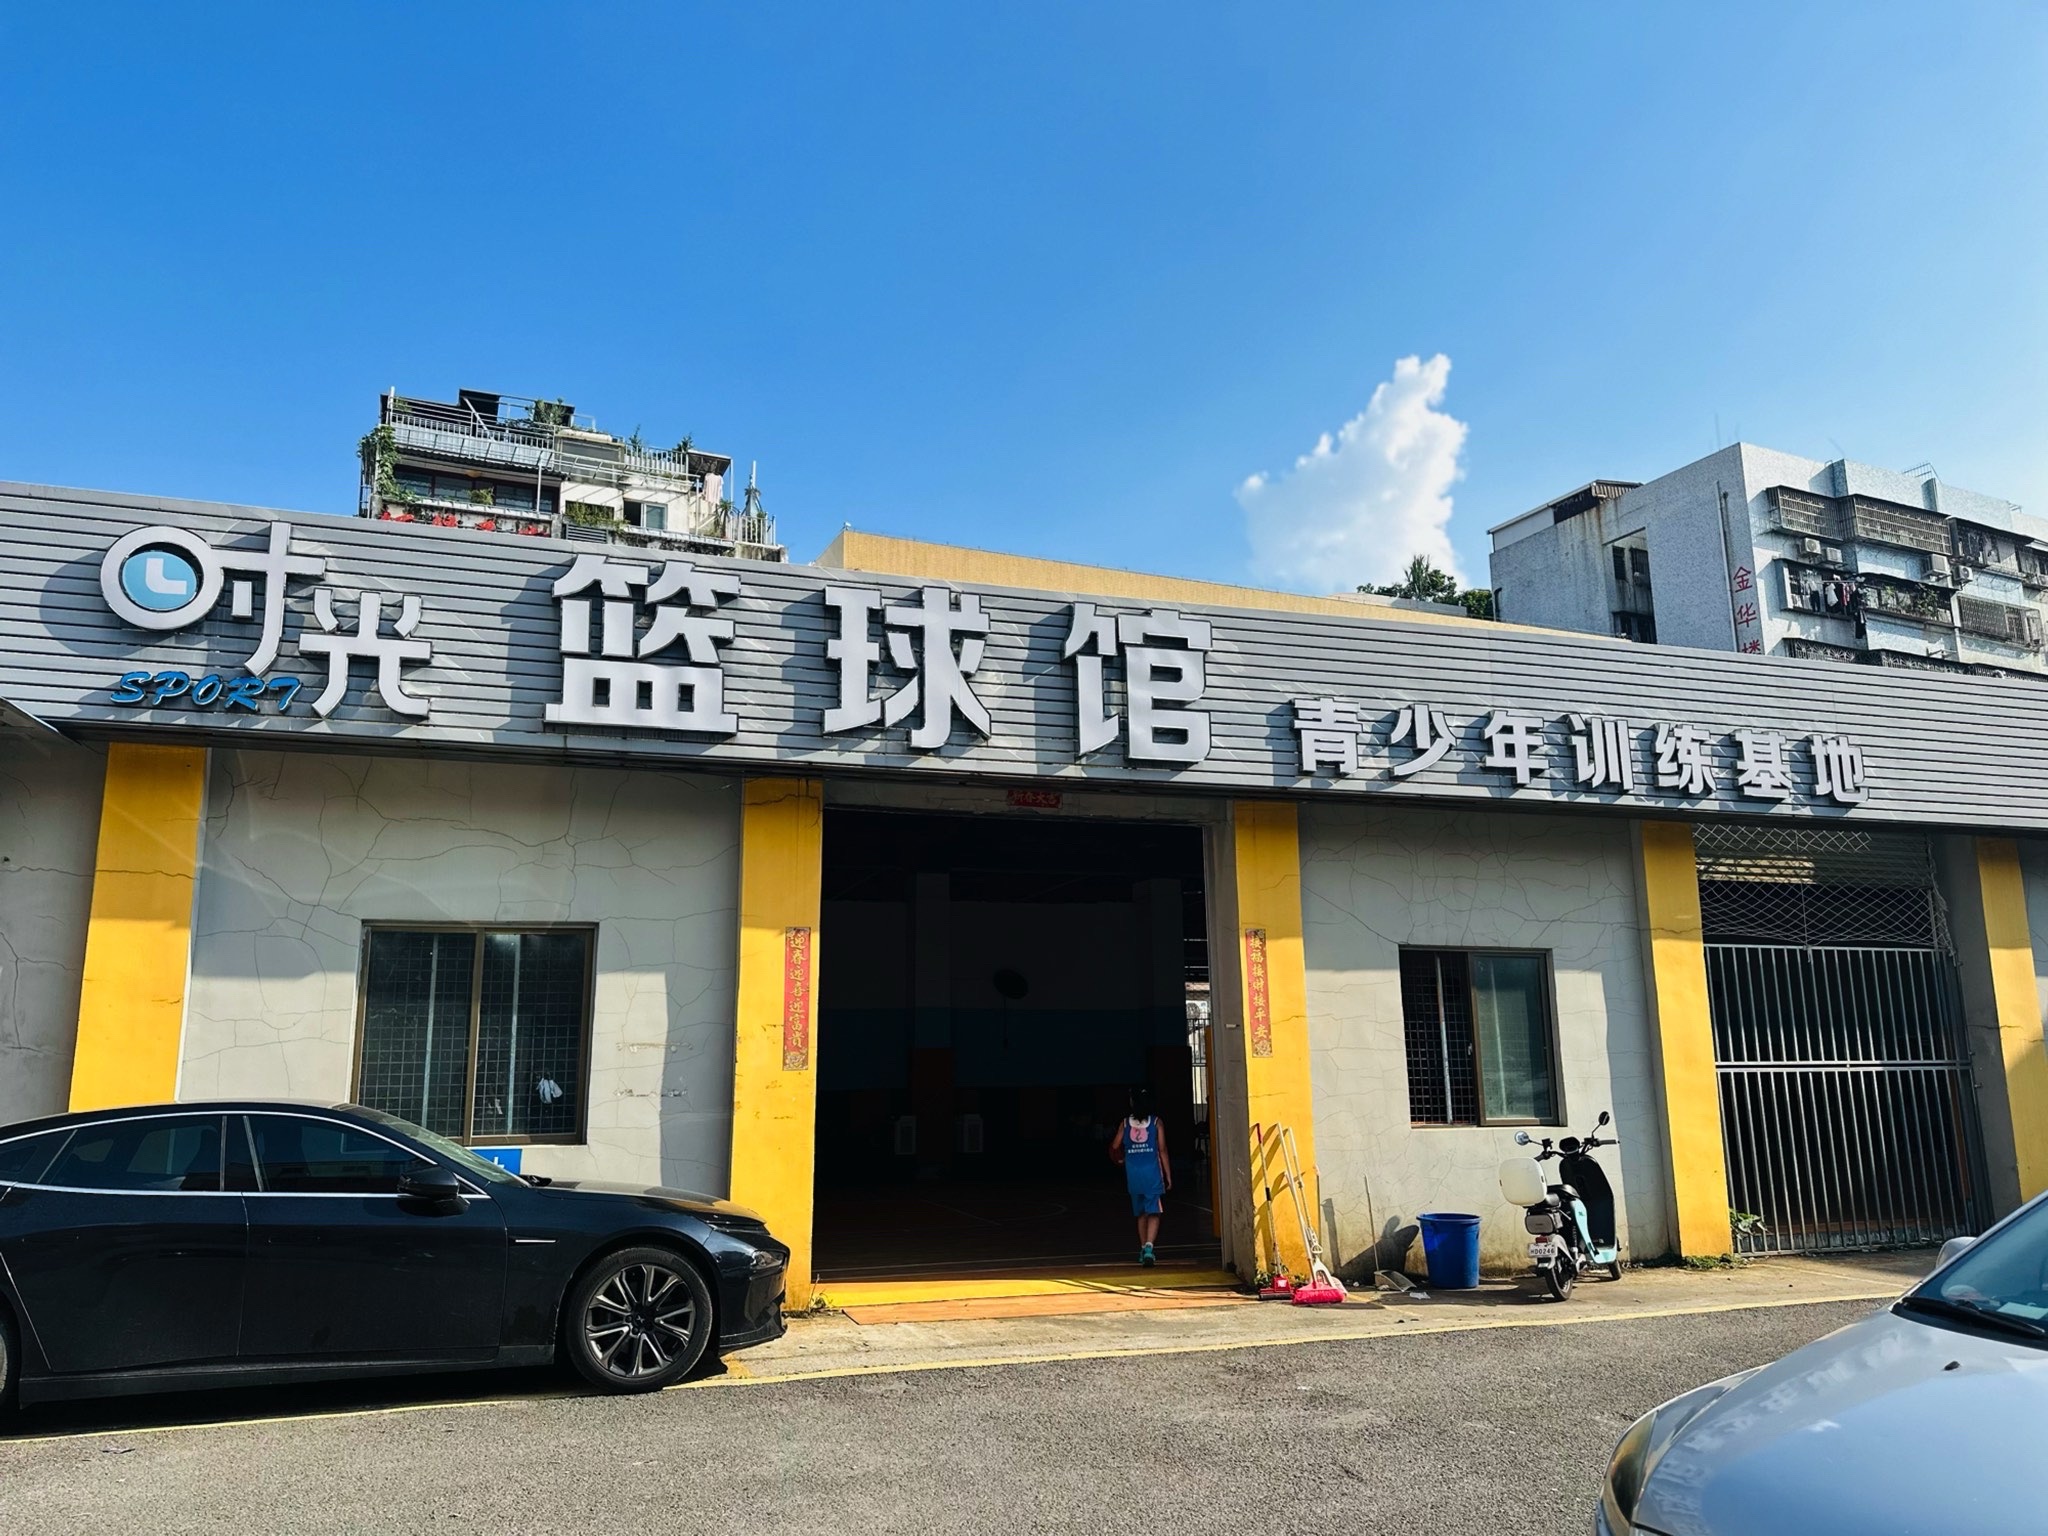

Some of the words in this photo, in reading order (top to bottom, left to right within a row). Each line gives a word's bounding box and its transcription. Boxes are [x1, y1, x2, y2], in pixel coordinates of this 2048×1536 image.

[110, 671, 303, 712] SPORT
[1293, 697, 1870, 803] 青少年训练基地
